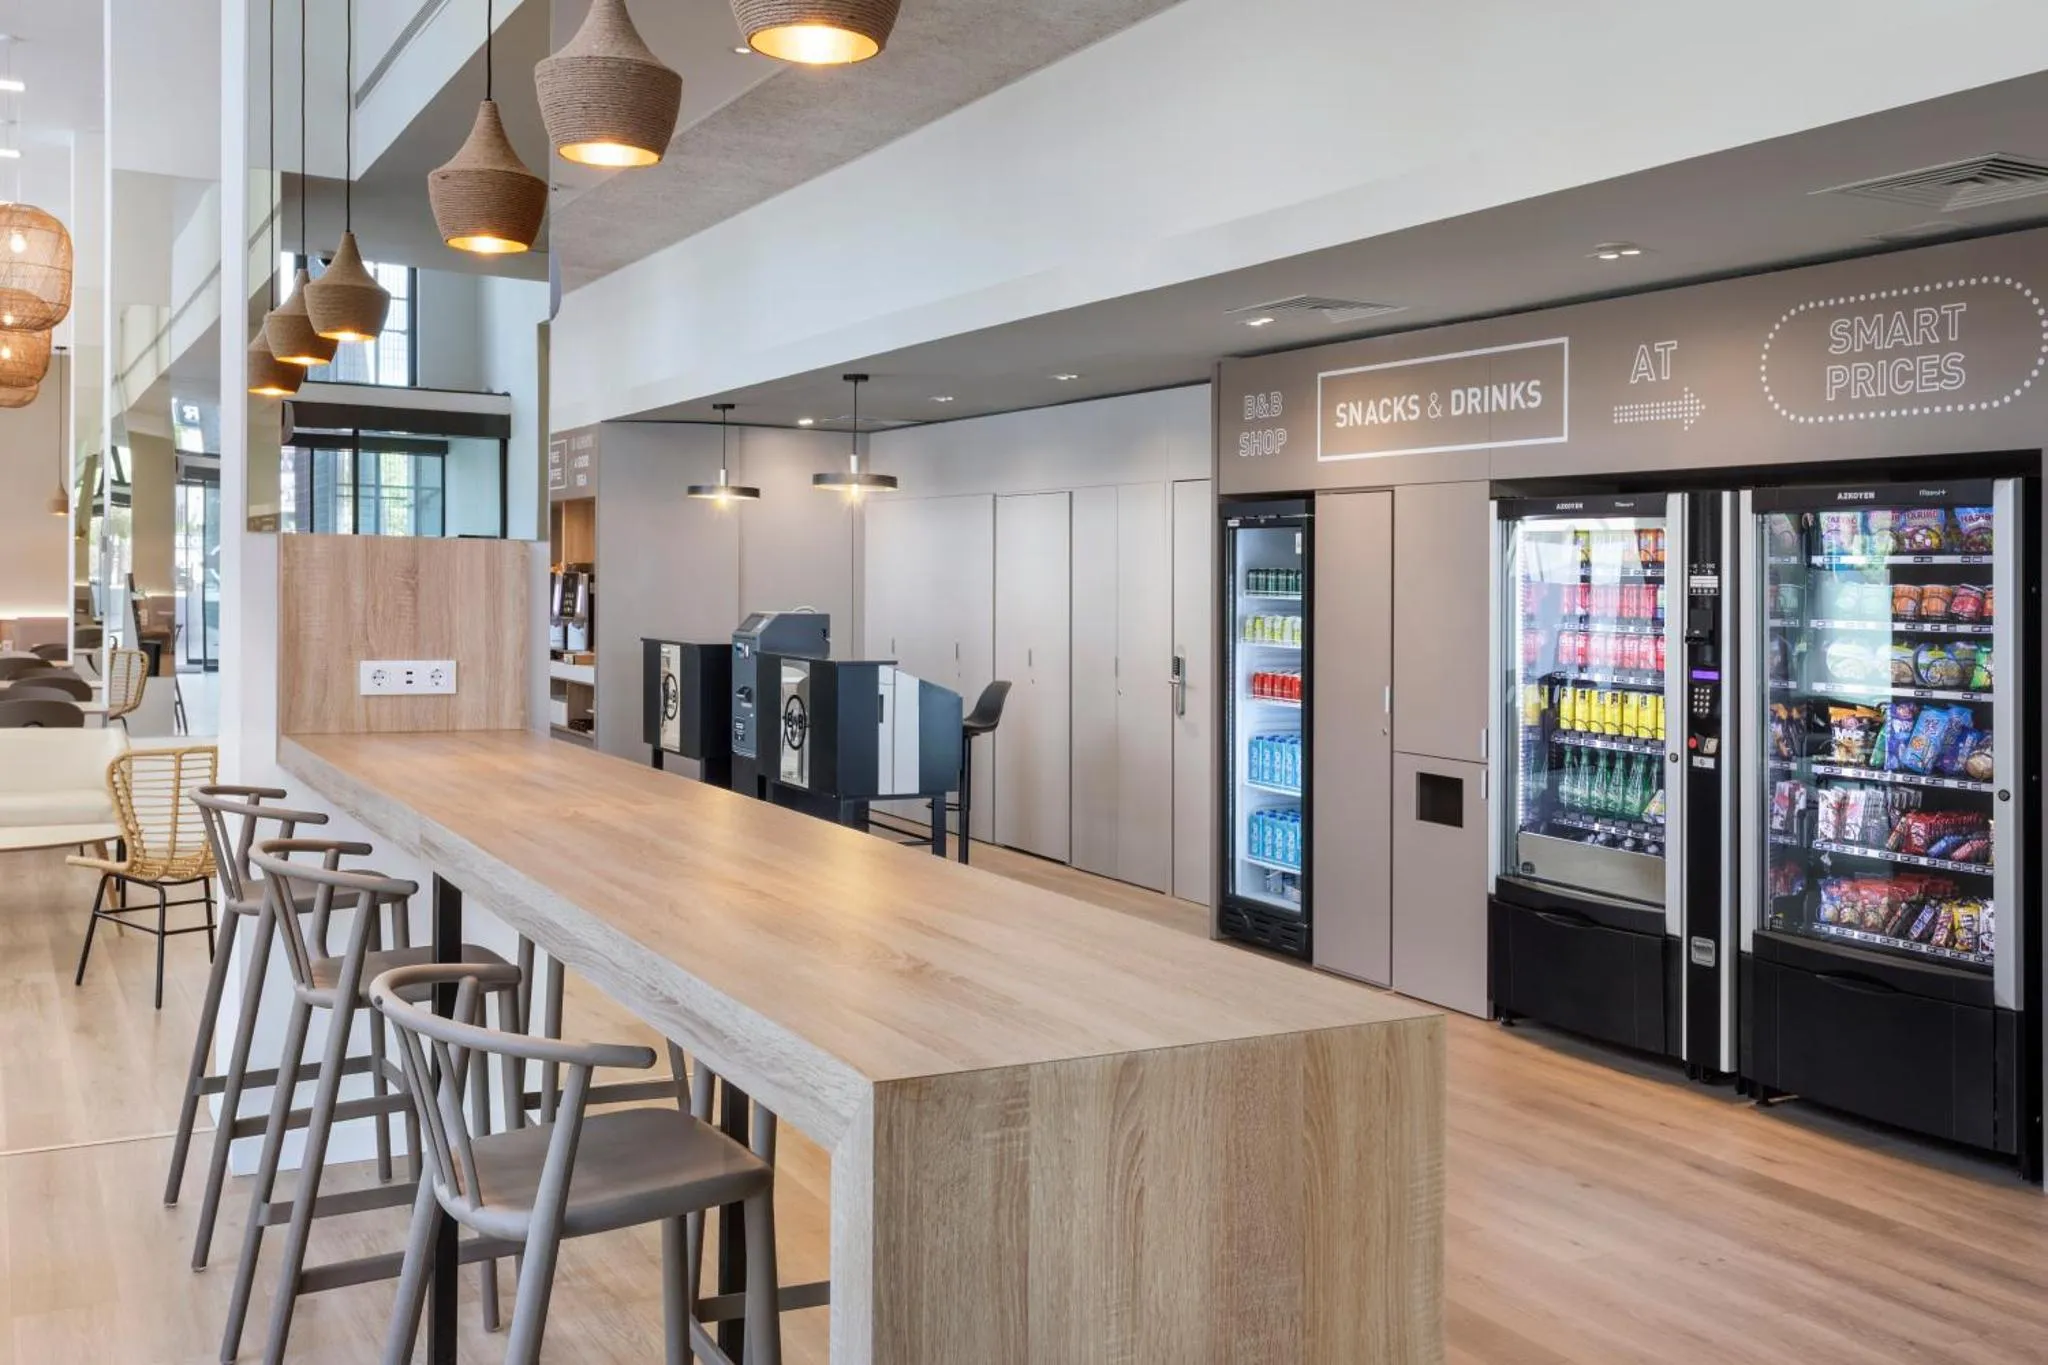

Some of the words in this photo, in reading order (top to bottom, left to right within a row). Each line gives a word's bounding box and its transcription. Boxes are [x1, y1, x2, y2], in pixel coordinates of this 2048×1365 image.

[1828, 302, 1967, 355] SMART
[1630, 340, 1678, 384] AT
[1826, 352, 1966, 401] PRICES
[1244, 391, 1283, 420] B&B
[1335, 394, 1421, 428] SNACKS
[1427, 391, 1443, 419] &
[1450, 379, 1543, 416] DRINKS
[1239, 428, 1287, 457] SHOP
